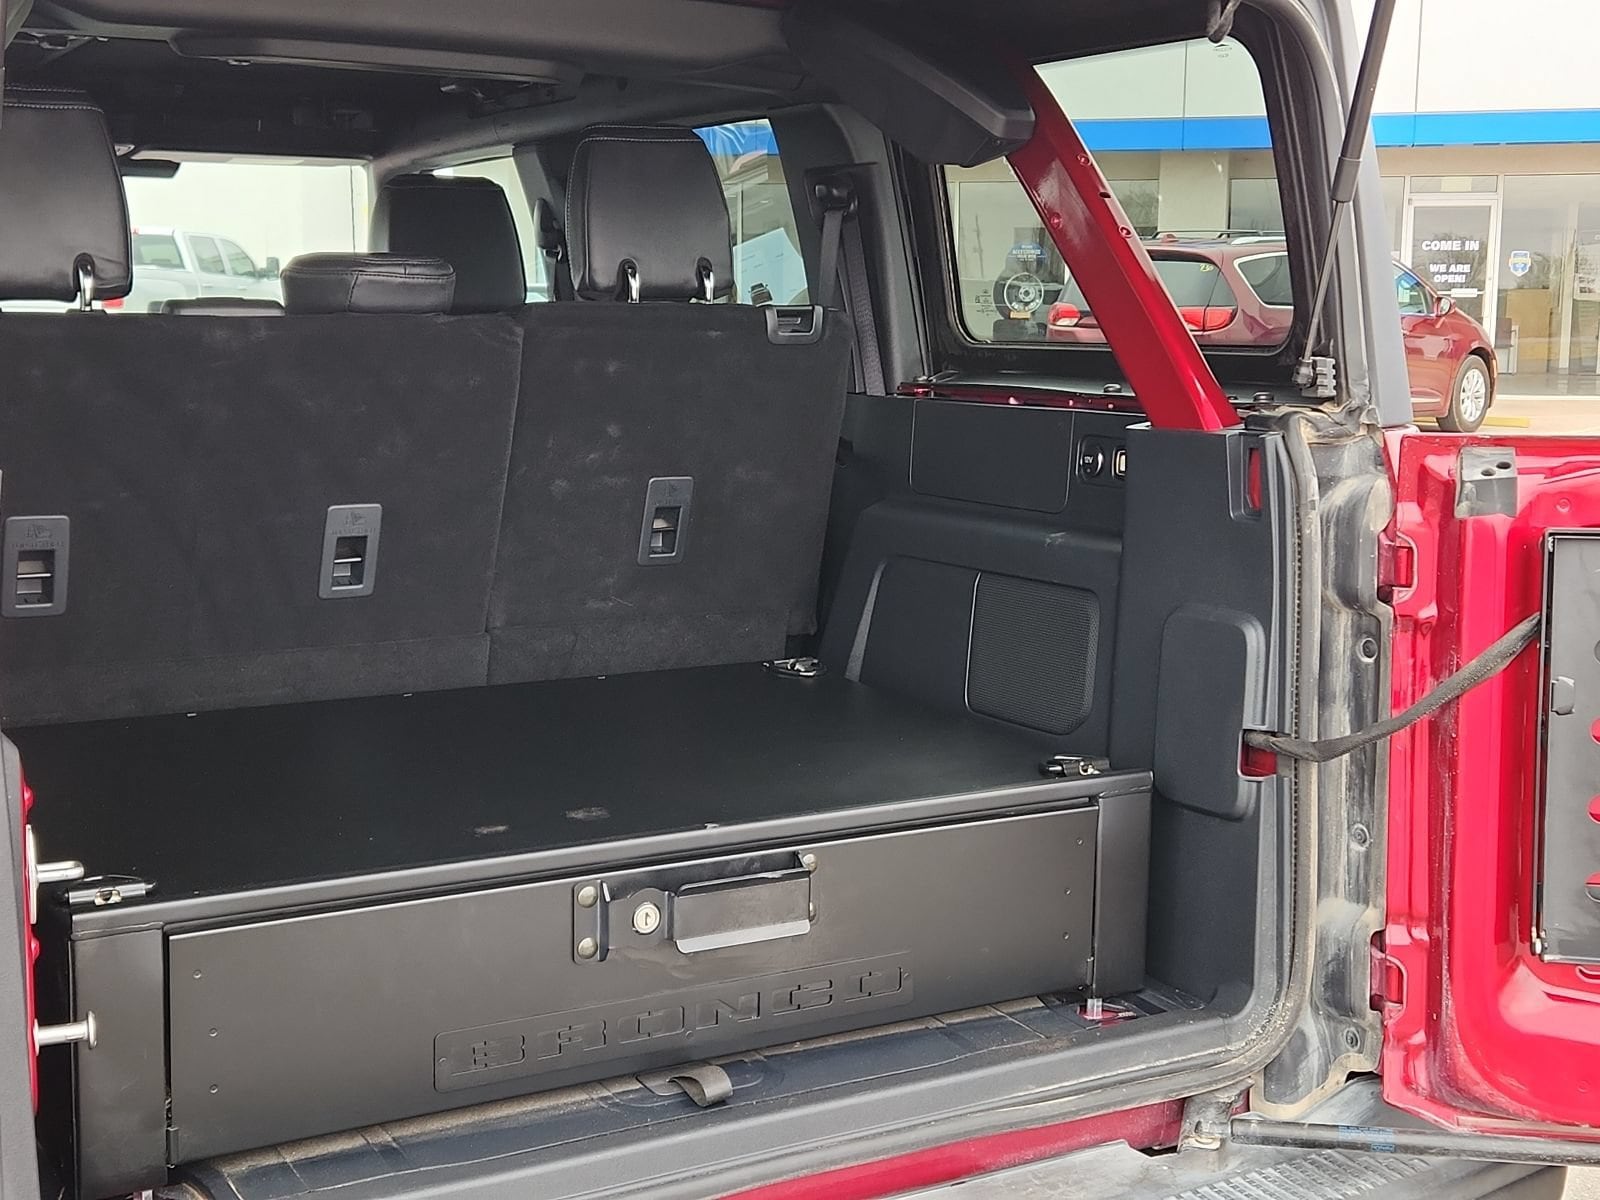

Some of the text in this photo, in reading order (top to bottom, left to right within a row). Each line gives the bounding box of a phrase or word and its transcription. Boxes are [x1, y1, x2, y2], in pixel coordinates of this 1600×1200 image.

[1421, 240, 1480, 251] COME IN
[1429, 263, 1471, 273] WE ARE
[1433, 274, 1466, 283] OPEN!
[450, 966, 904, 1076] BRONCO
